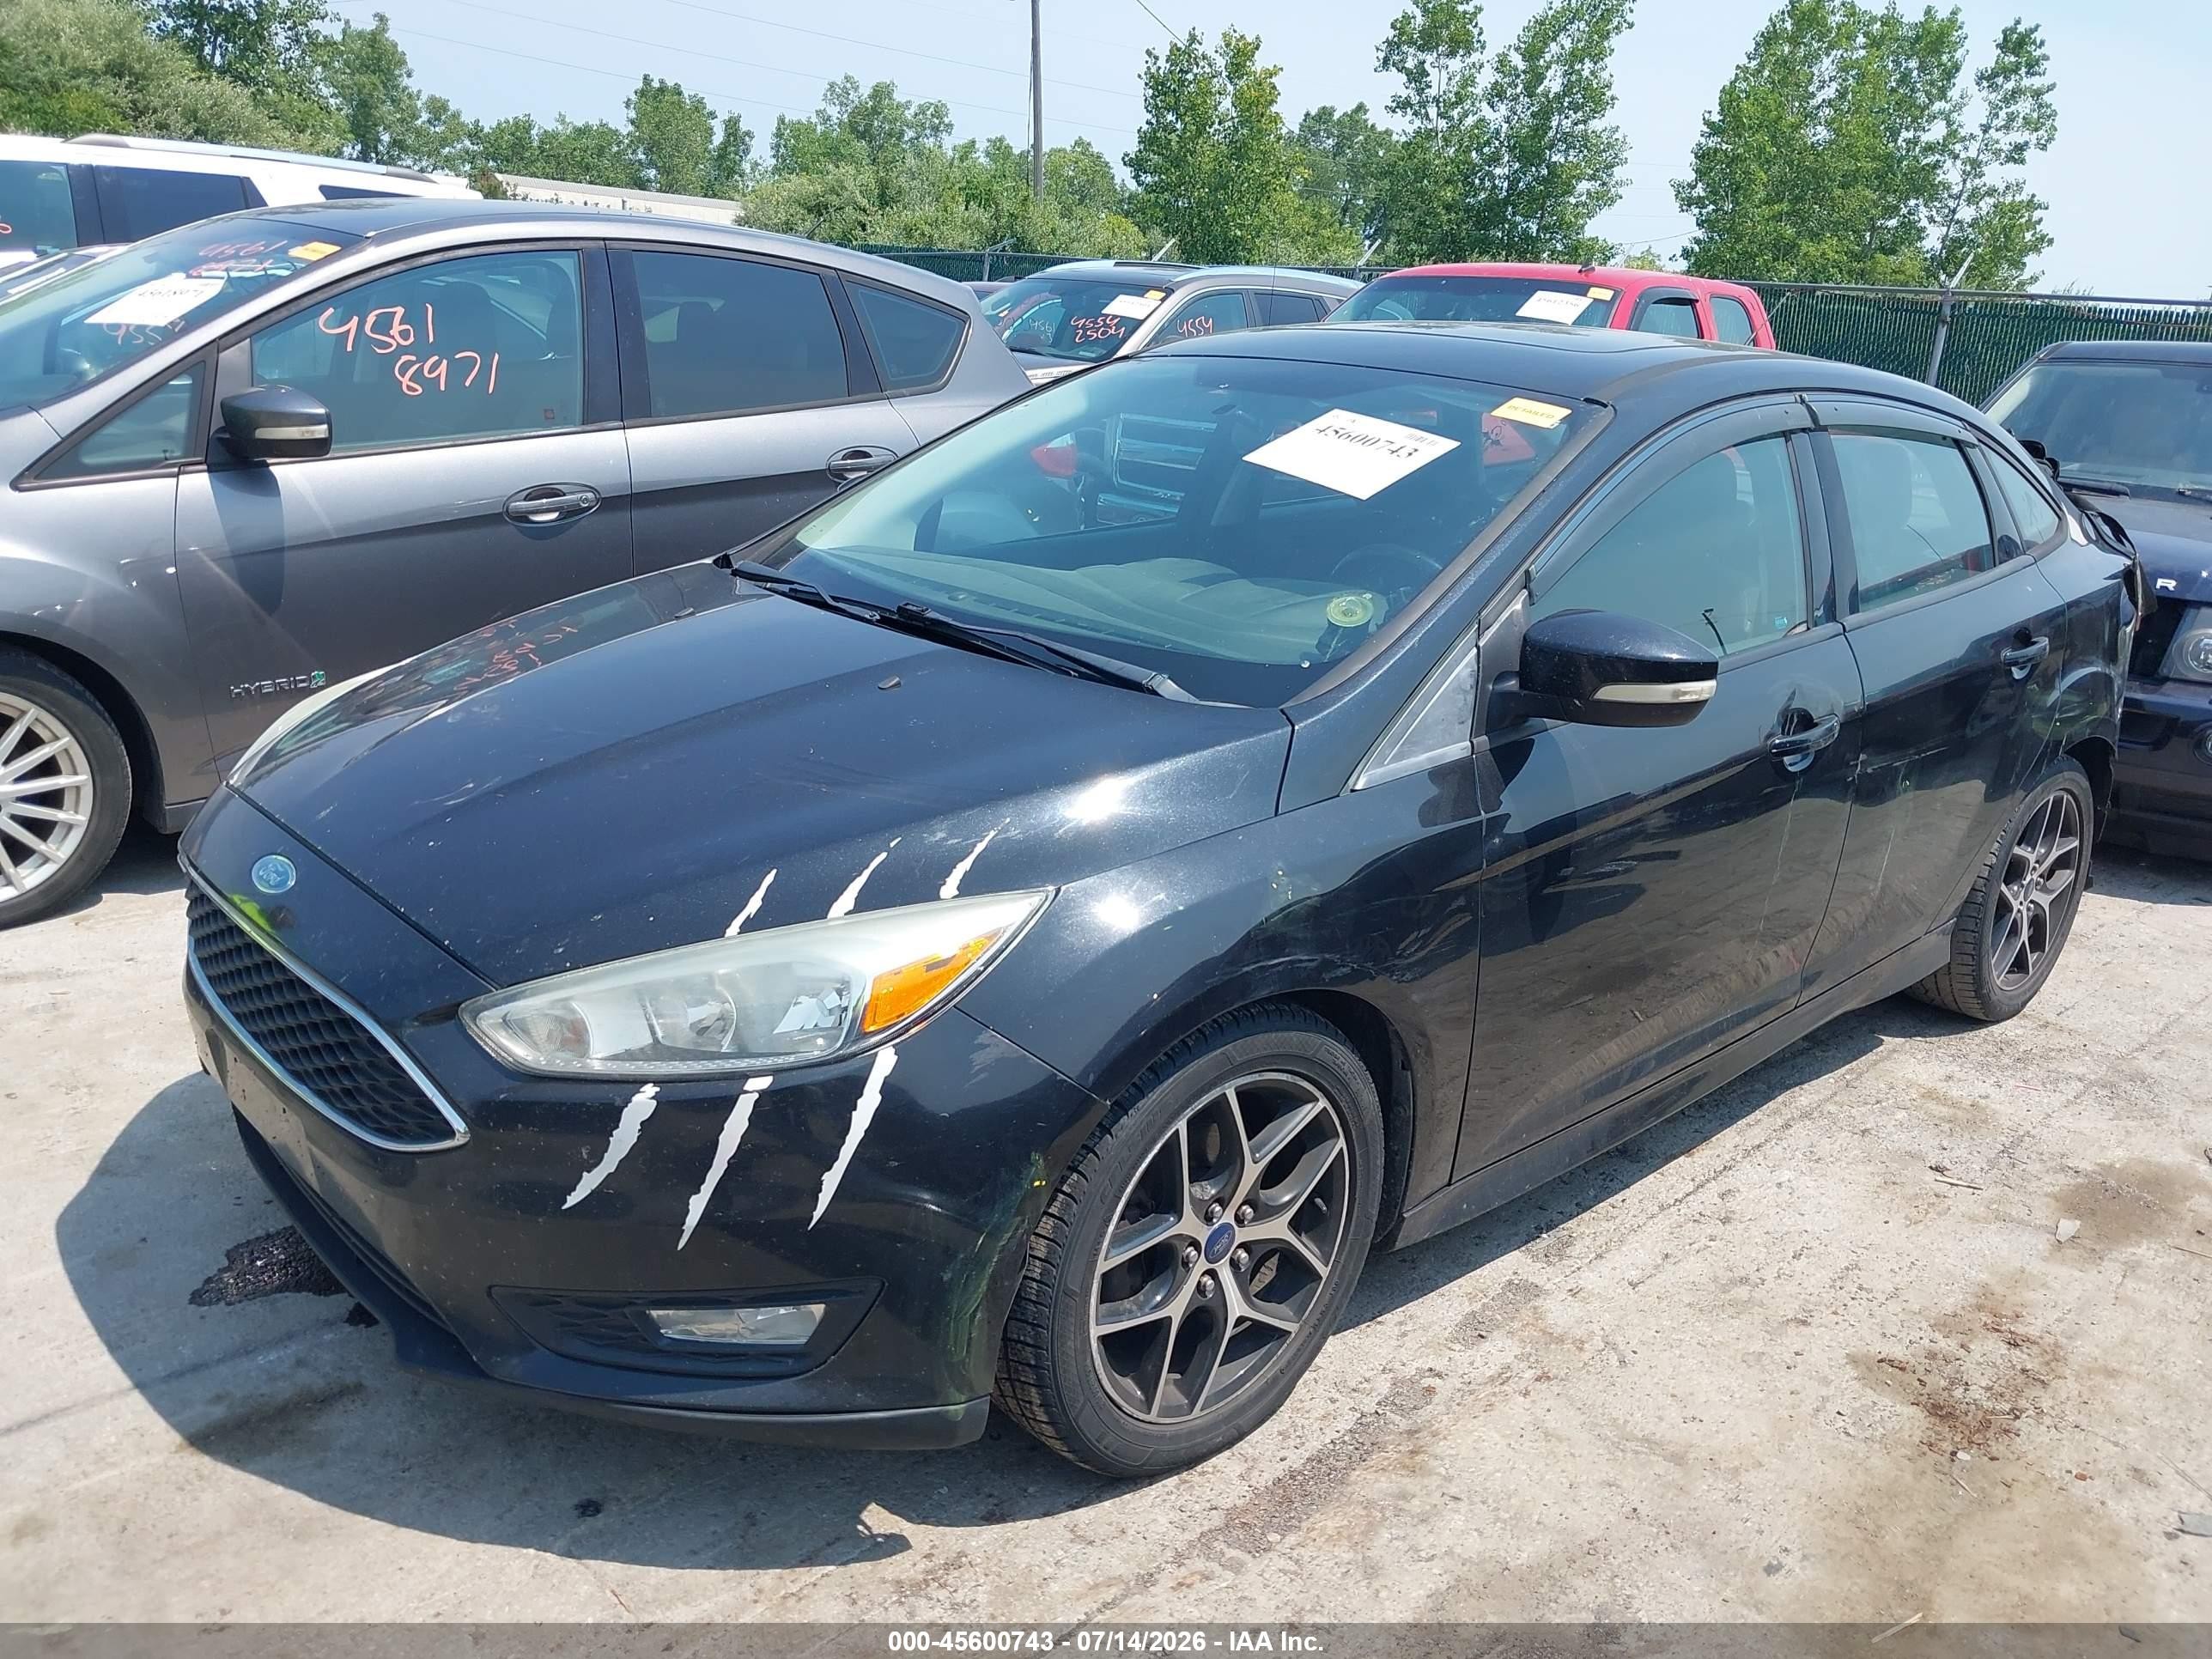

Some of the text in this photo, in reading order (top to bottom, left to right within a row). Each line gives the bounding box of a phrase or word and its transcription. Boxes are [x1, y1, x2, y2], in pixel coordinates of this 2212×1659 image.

[319, 303, 434, 354] 4561
[1070, 315, 1121, 330] 4554
[1176, 315, 1213, 337] 4554
[1074, 325, 1126, 343] 2504
[394, 351, 500, 396] 8971
[1315, 425, 1419, 459] 45600743
[230, 676, 310, 698] HYBRID
